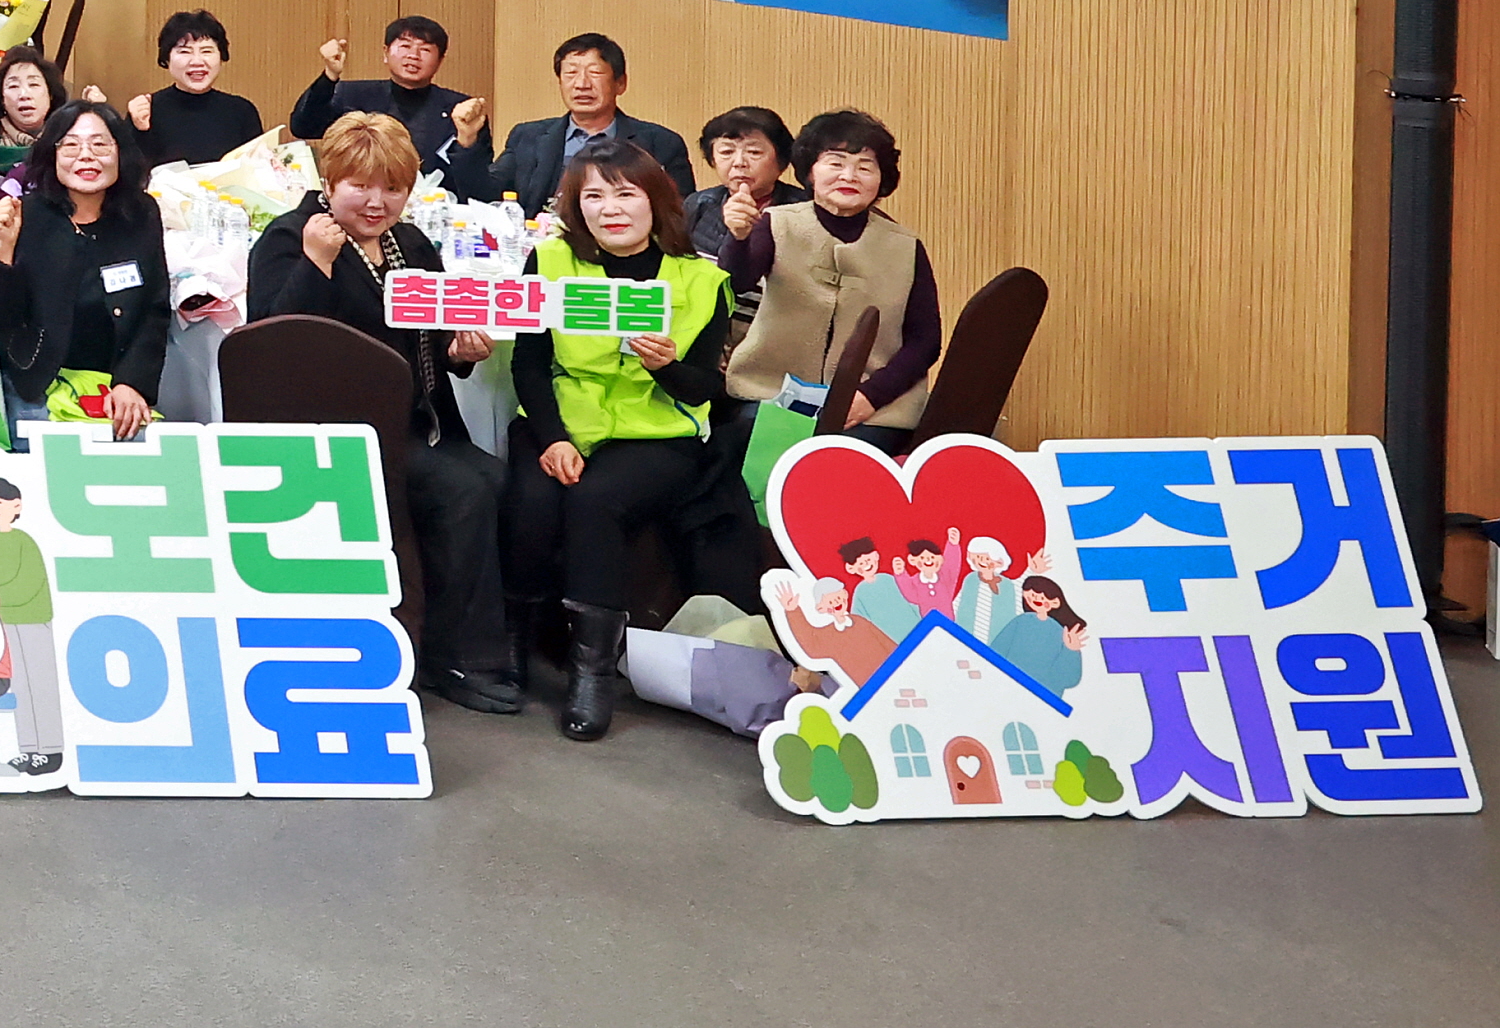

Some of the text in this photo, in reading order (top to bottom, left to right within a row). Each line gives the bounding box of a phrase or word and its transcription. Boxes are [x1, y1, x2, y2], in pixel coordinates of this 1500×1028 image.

[391, 276, 665, 332] 촘촘한 돌봄
[41, 433, 390, 595] 보건
[1055, 448, 1415, 613] 주거
[65, 614, 420, 785] 의료
[1099, 631, 1470, 807] 지원
